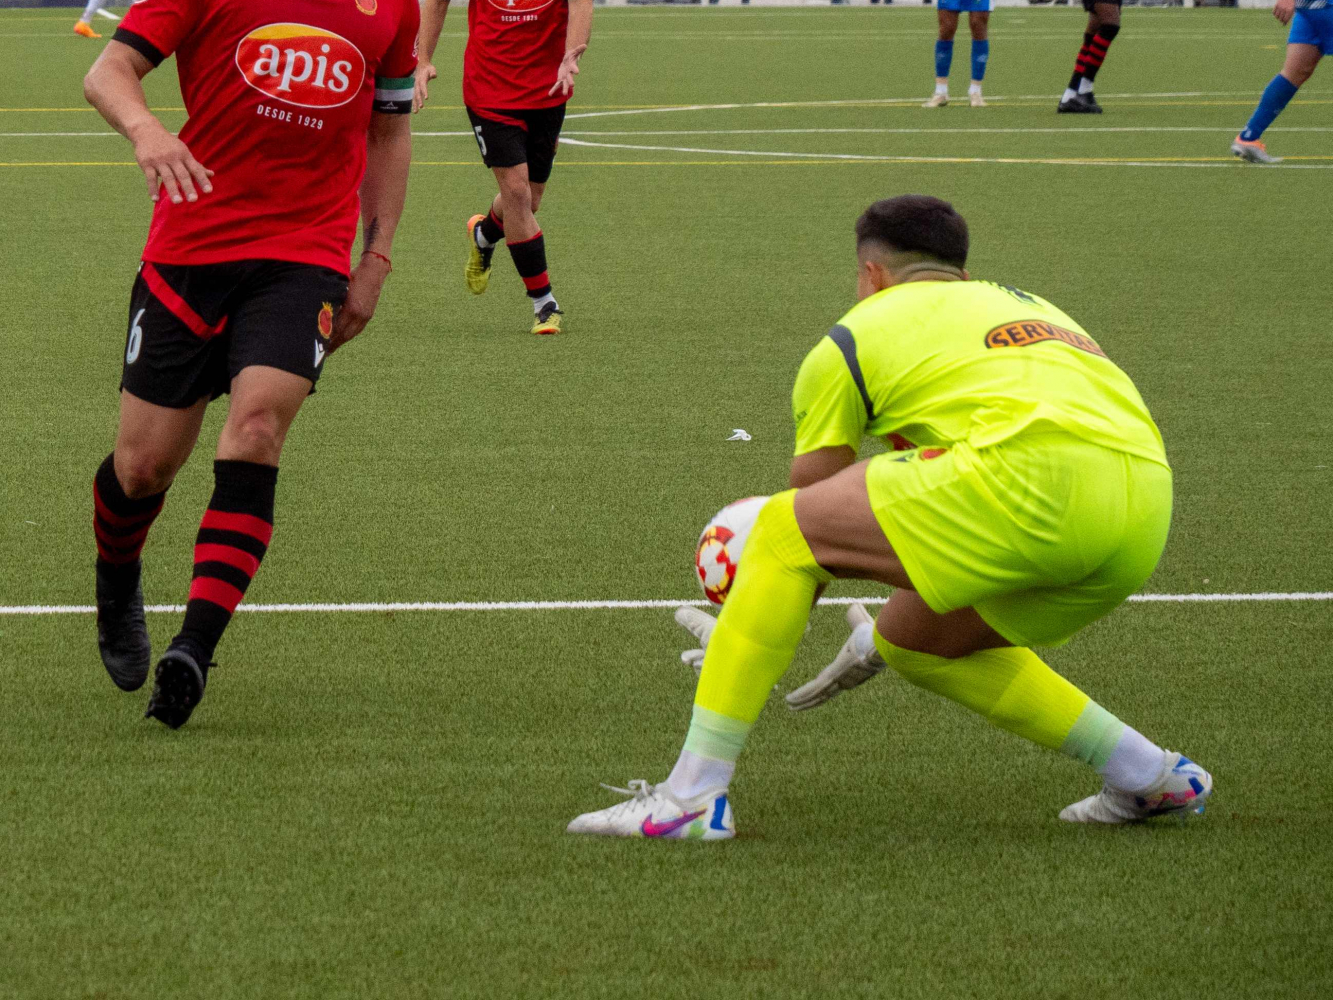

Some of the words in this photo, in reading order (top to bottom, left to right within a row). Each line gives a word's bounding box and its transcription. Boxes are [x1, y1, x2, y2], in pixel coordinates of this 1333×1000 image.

[501, 14, 521, 22] DESDE
[253, 43, 352, 93] apis
[257, 104, 292, 123] DESDE
[297, 114, 324, 130] 1929
[474, 125, 487, 156] 5
[126, 308, 146, 365] 6
